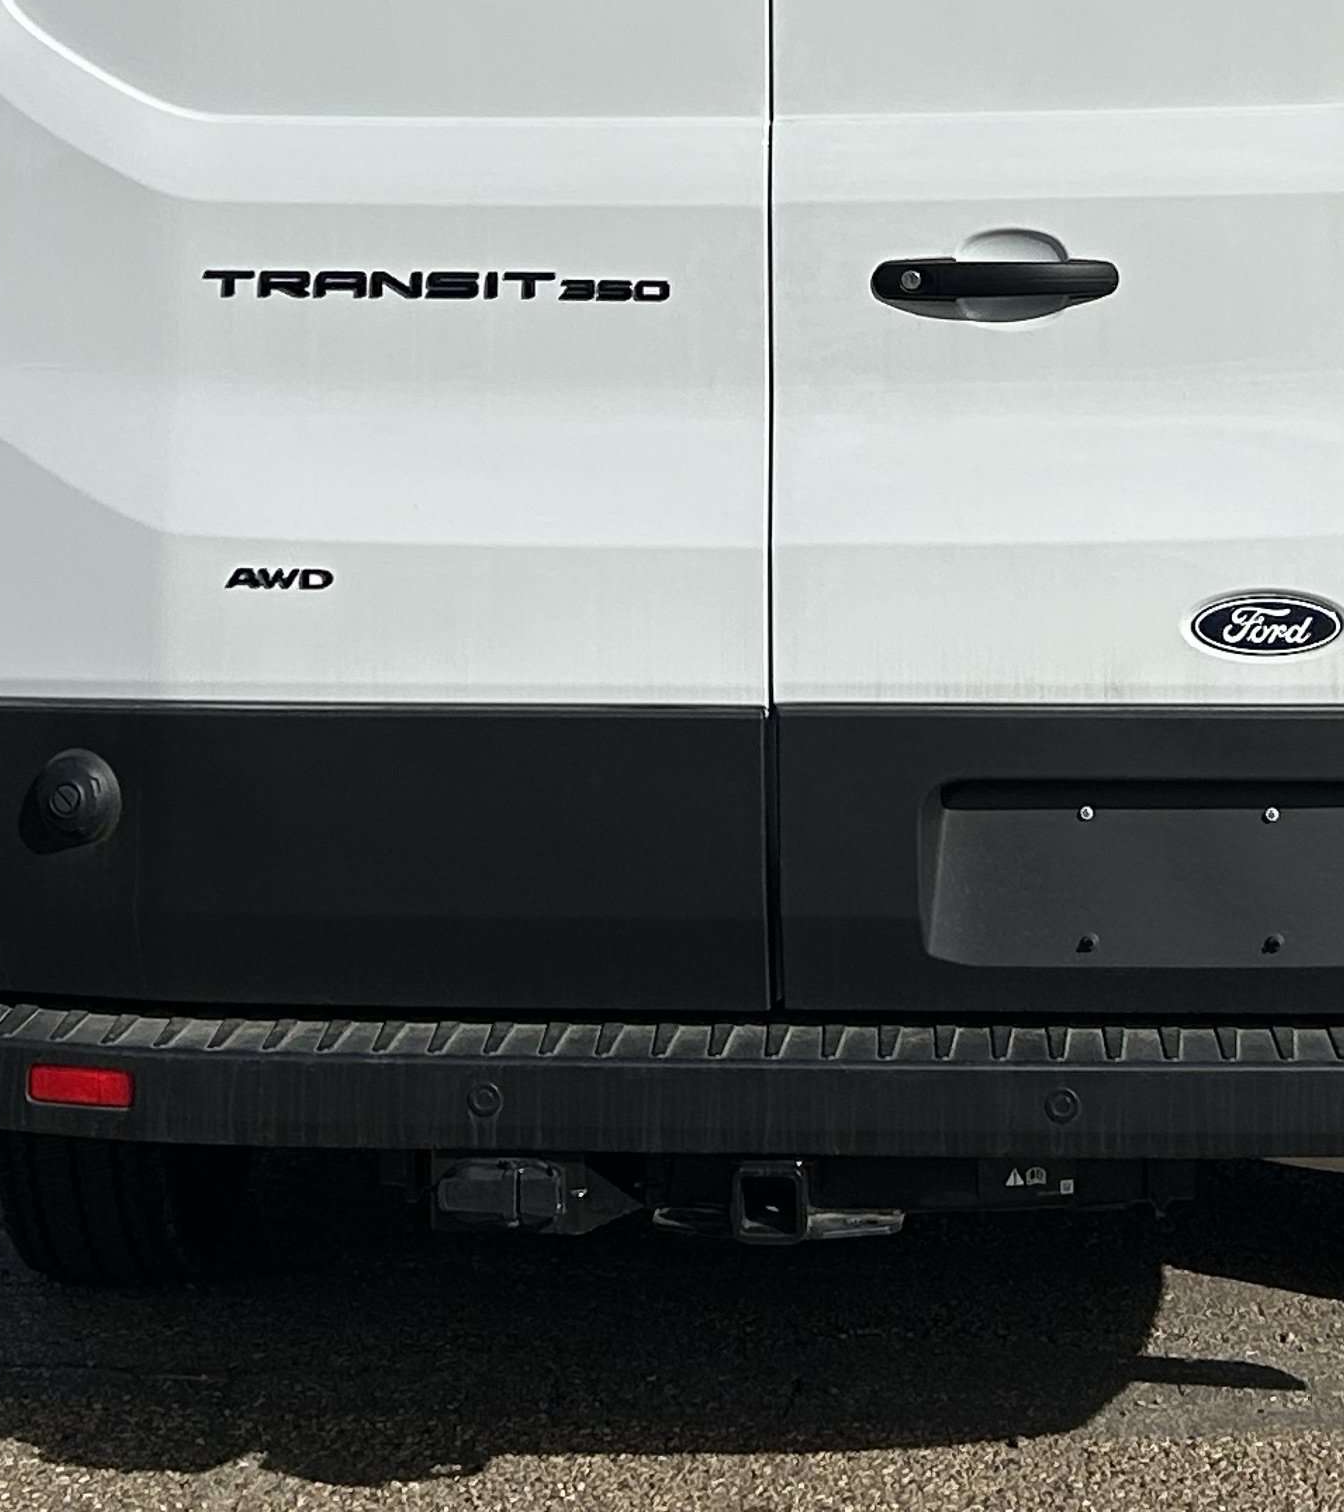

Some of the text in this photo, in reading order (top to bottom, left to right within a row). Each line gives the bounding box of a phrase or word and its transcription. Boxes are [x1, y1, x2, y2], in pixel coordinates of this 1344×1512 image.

[202, 270, 671, 302] TRANSIT 350
[224, 567, 335, 590] AWD
[1222, 606, 1313, 645] Ford
